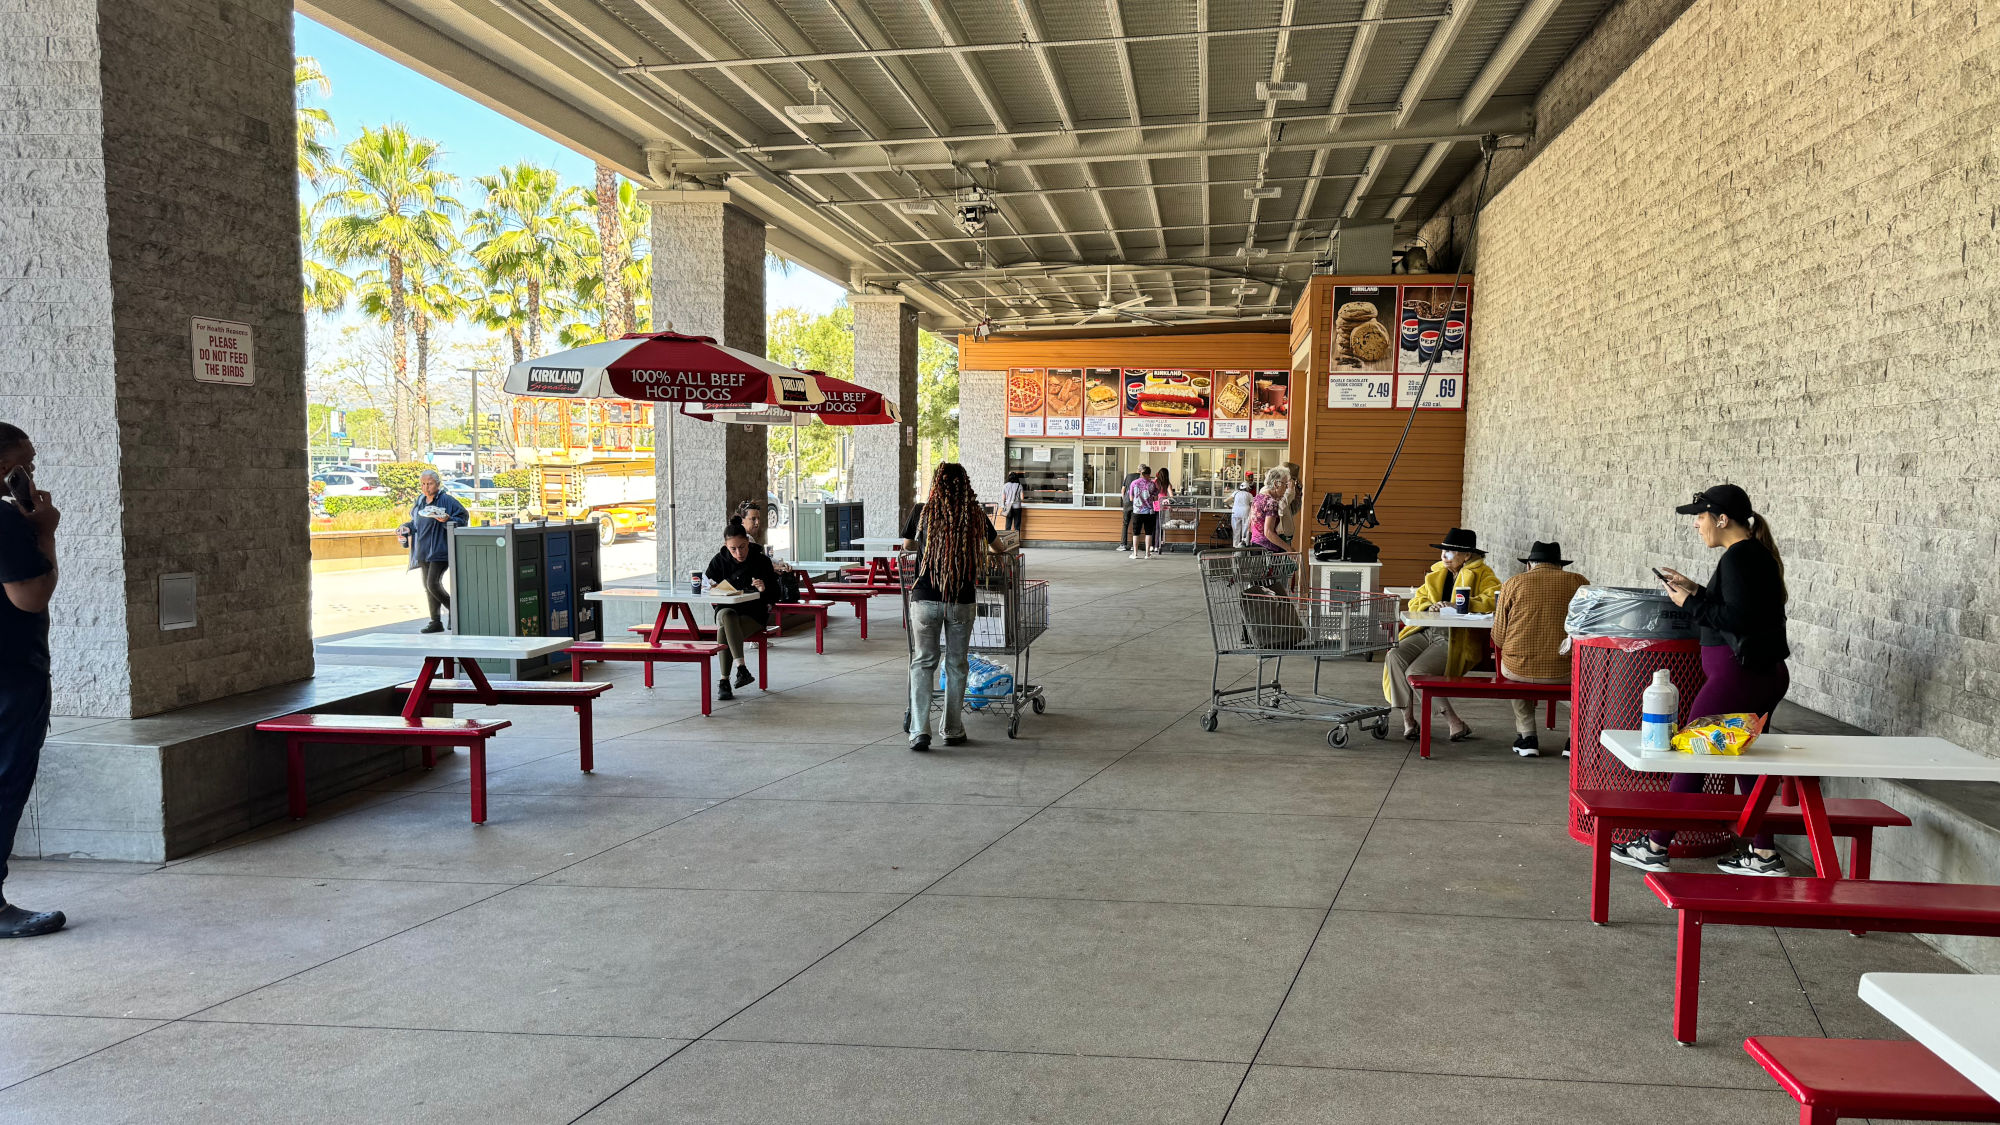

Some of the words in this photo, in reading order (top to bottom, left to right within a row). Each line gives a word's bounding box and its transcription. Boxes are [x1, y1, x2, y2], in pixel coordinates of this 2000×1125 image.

[209, 336, 237, 349] PLEASE
[200, 349, 209, 360] DO
[213, 350, 227, 362] NOT
[230, 352, 248, 364] FEED
[205, 363, 219, 375] THE
[222, 365, 244, 377] BIRDS
[531, 369, 581, 383] KIRKLAND
[631, 370, 670, 383] 100%
[676, 372, 706, 385] ALL
[711, 373, 746, 387] BEEF
[530, 382, 579, 392] Signature
[646, 386, 680, 399] HOT
[685, 387, 732, 401] DOGS
[1368, 383, 1389, 397] 2.49
[1436, 379, 1456, 398] .69
[843, 392, 866, 402] BEEF
[826, 402, 856, 412] DOGS
[1065, 420, 1080, 430] 3.99
[1187, 421, 1205, 436] 1.50
